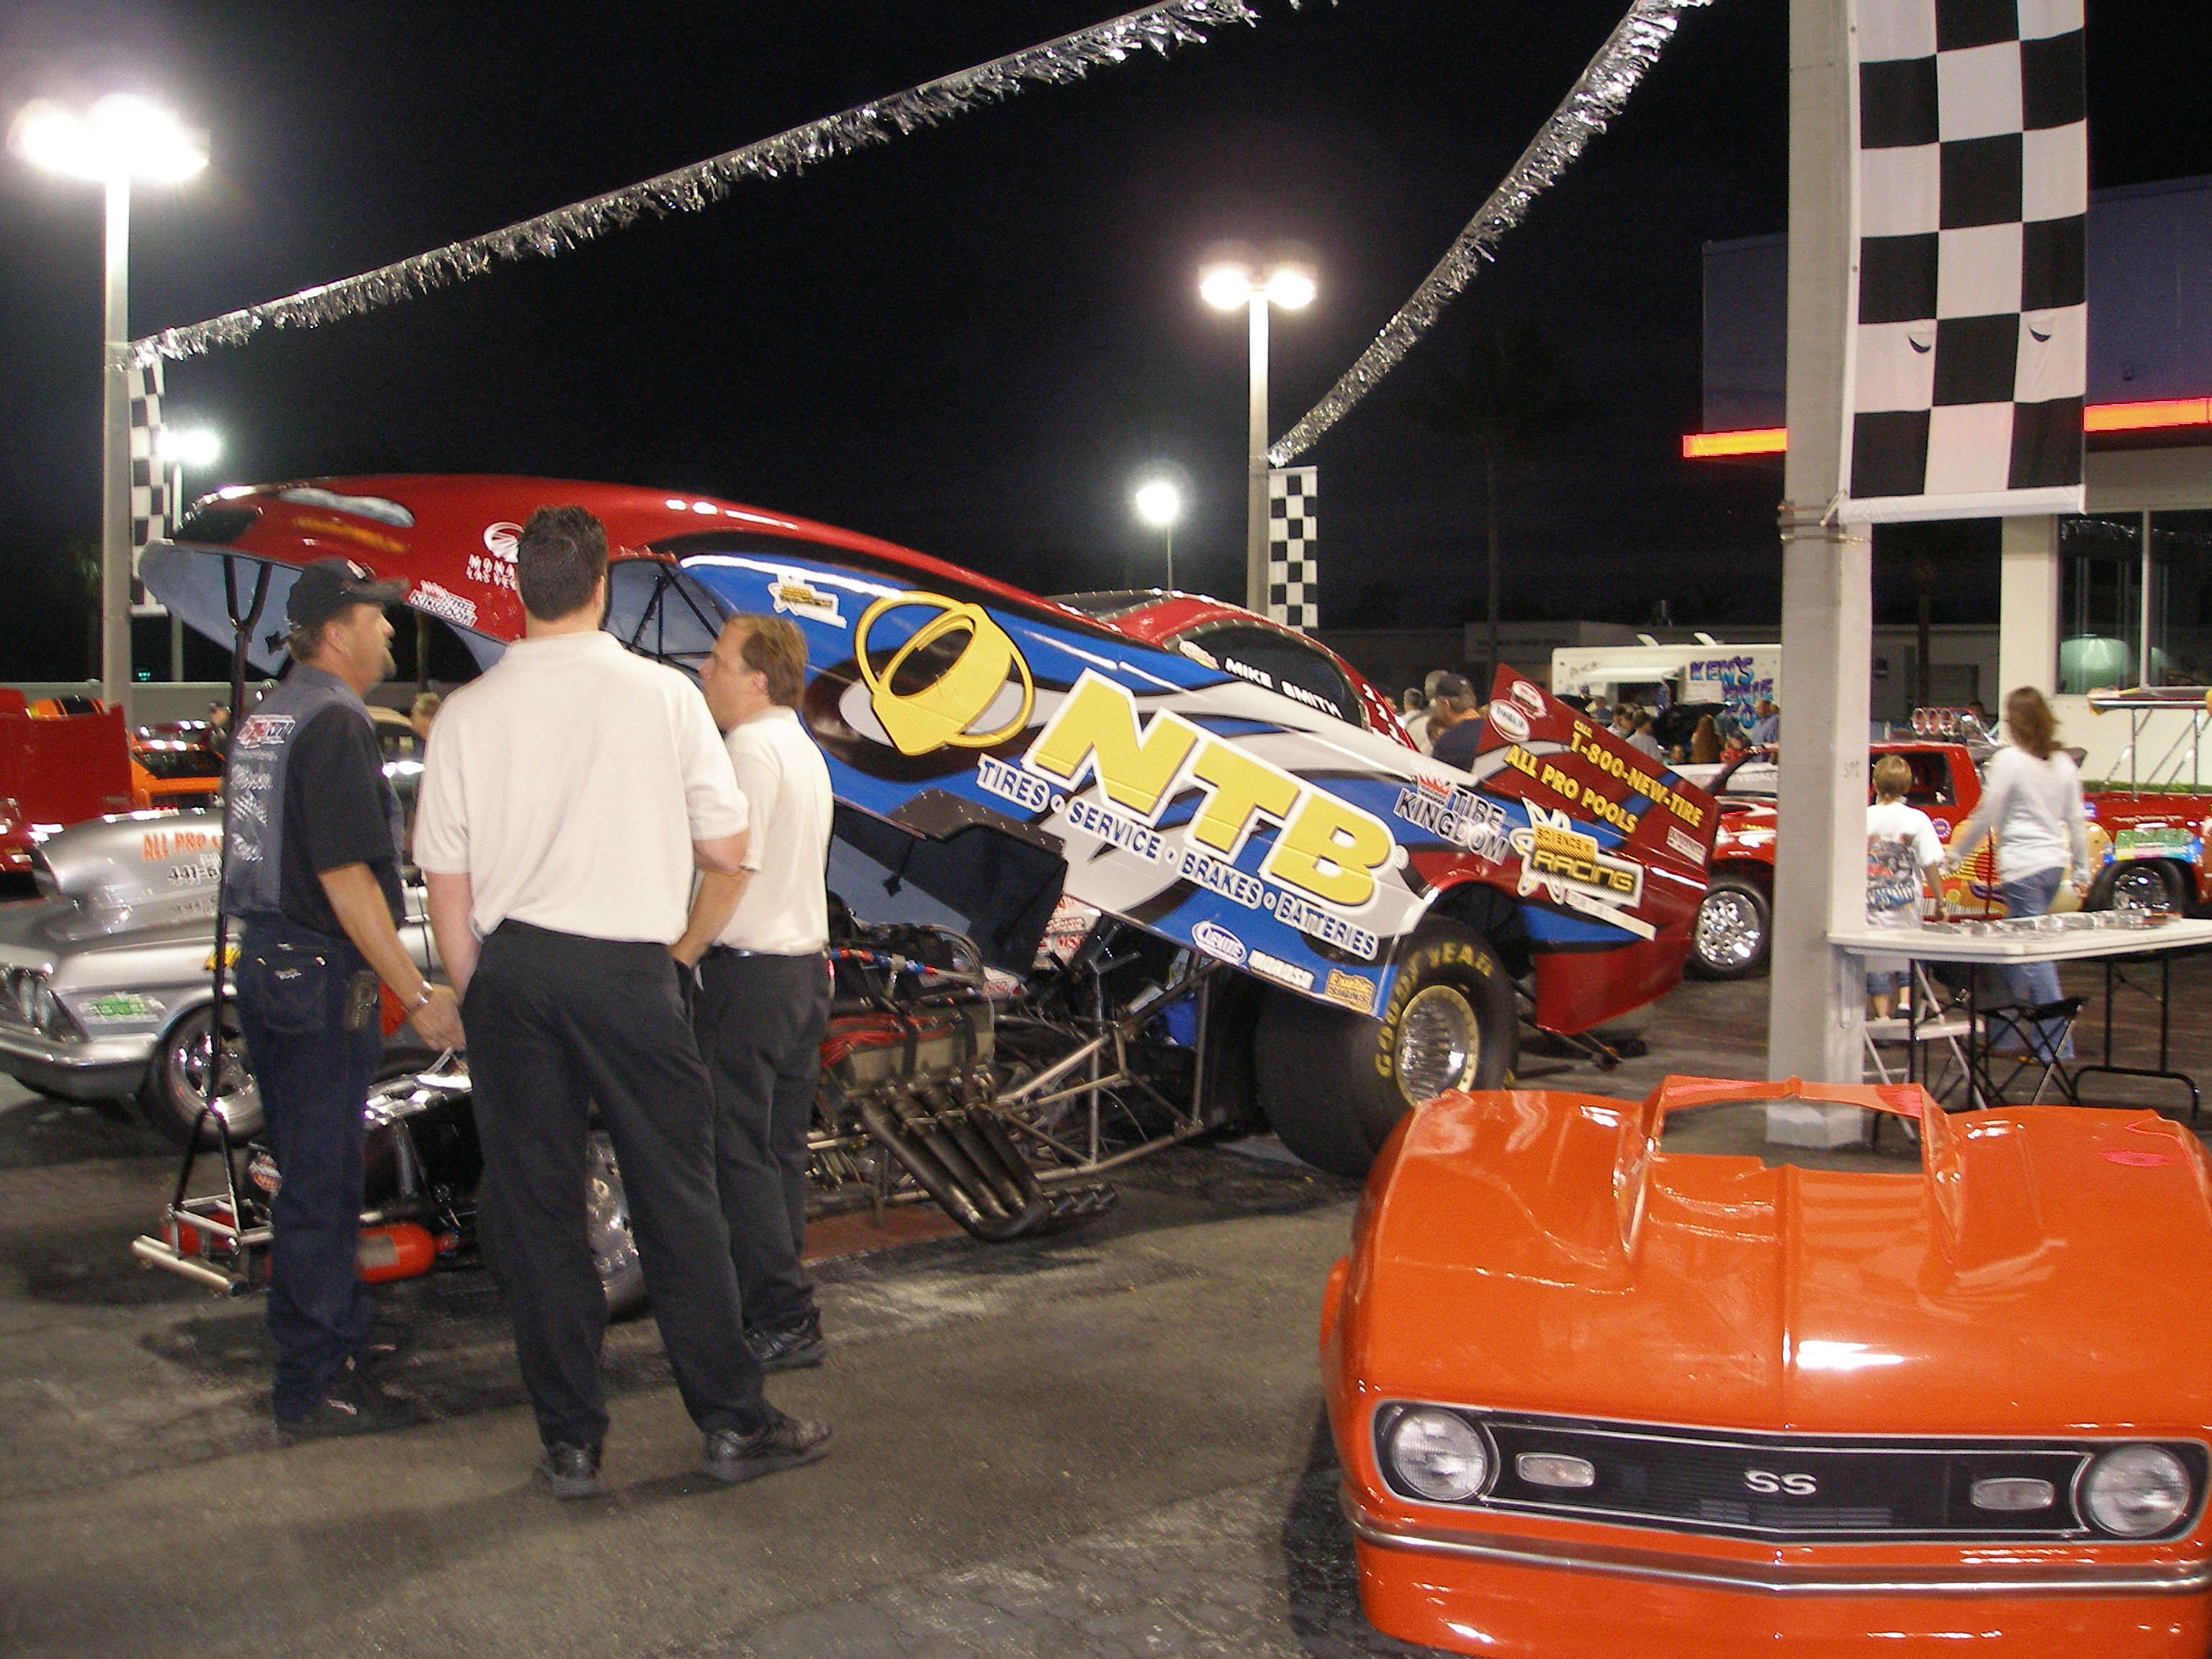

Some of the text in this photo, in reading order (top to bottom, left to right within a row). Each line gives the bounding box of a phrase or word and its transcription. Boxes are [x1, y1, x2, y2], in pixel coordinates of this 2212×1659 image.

[493, 574, 517, 590] VEG
[409, 590, 477, 626] KINGDOM
[1226, 657, 1344, 719] MIKE SMITH
[1030, 673, 1394, 907] NTB
[1452, 786, 1506, 837] TIRE
[1504, 744, 1638, 834] ALL PRO POOLS
[143, 834, 170, 864] ALL
[174, 832, 206, 855] PRO
[1394, 788, 1510, 865] KINGDOM
[1537, 828, 1582, 850] SCIENCE
[984, 760, 1375, 956] TIRES SERVICE BRAKES BATTERIES
[1744, 1470, 1817, 1496] SS
